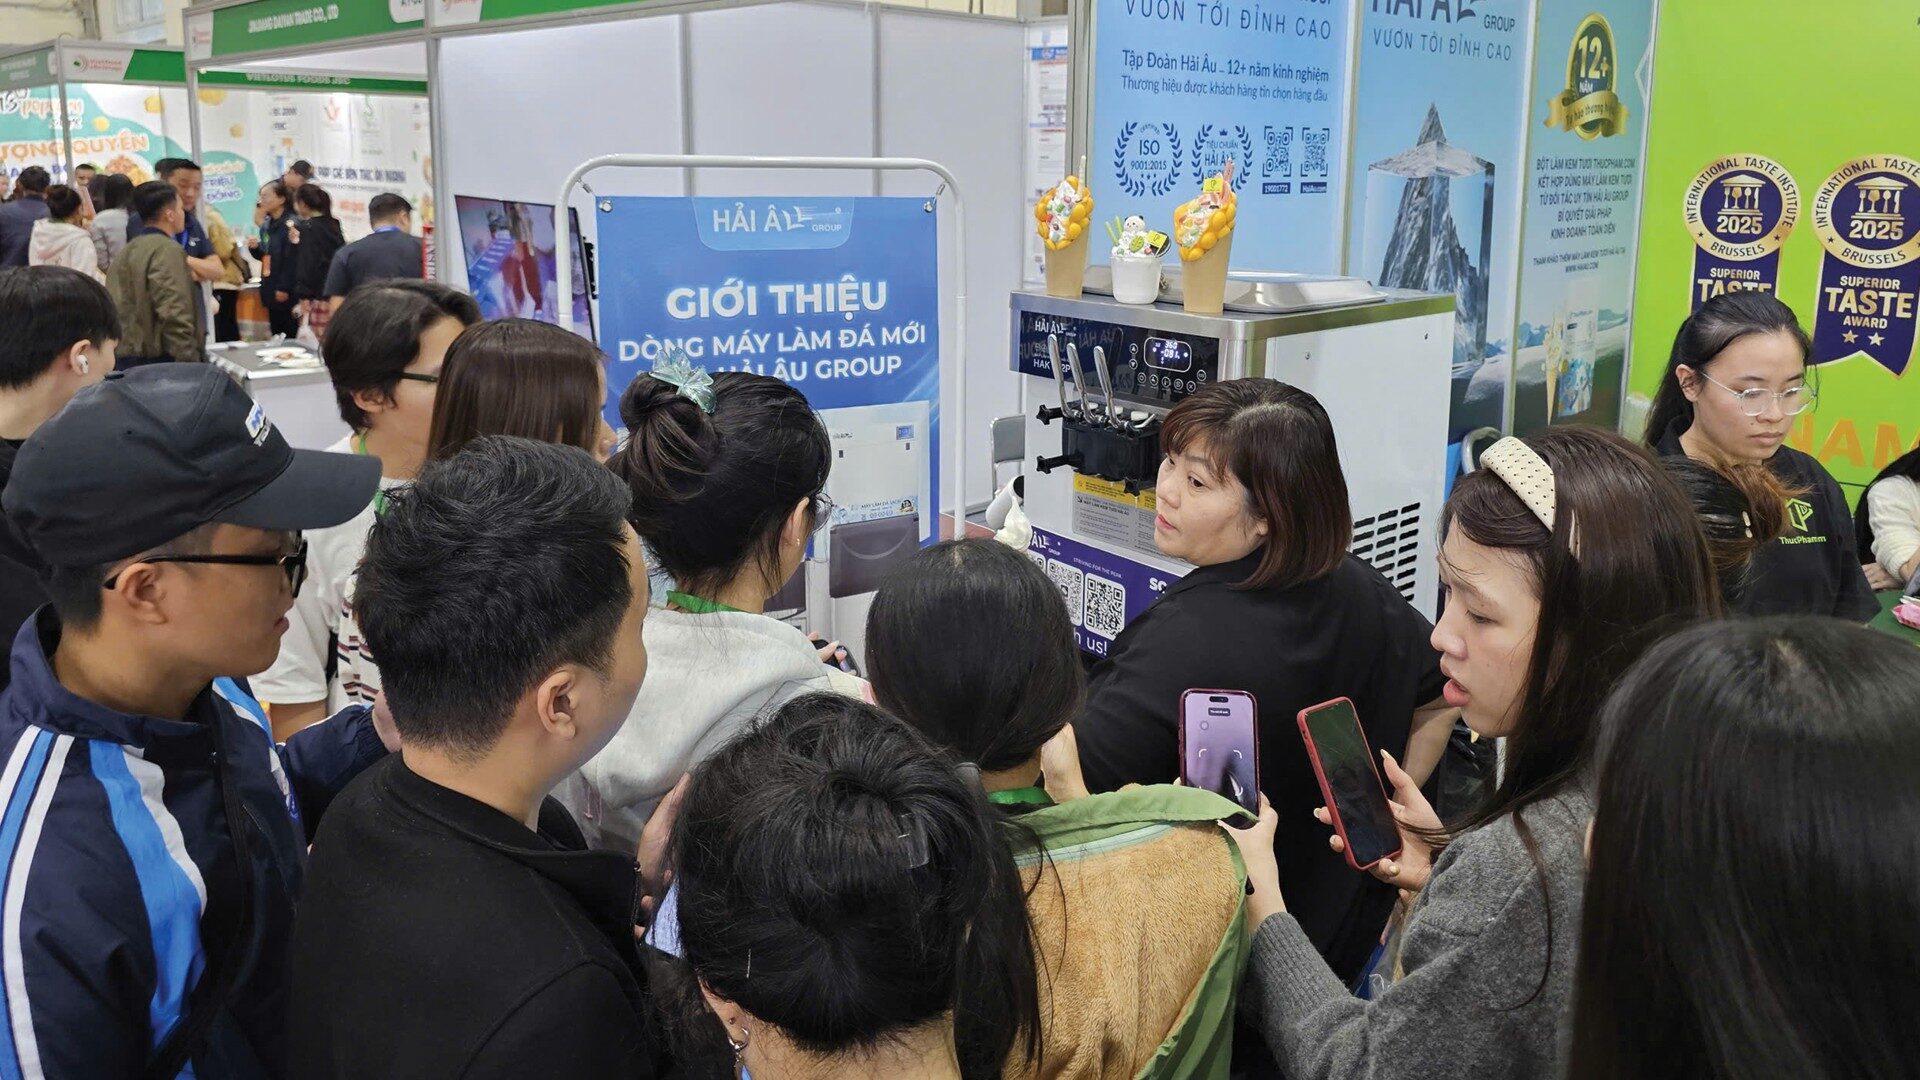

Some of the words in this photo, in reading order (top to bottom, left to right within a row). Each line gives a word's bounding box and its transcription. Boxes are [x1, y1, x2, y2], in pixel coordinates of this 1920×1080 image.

[1198, 1, 1229, 27] TỚI
[1240, 4, 1286, 34] ĐỈNH
[1296, 17, 1331, 40] CAO
[1484, 14, 1516, 32] GROUP
[1487, 43, 1512, 61] CAO
[1122, 50, 1143, 71] Tập
[1147, 52, 1177, 69] Đoàn
[1181, 54, 1199, 72] Hải
[1202, 53, 1217, 73] Âu
[1227, 60, 1246, 75] 12+
[1250, 64, 1270, 78] năm
[1273, 64, 1293, 79] kinh
[1295, 66, 1329, 83] nghiệm
[1121, 75, 1159, 94] Thương
[1162, 78, 1182, 93] hiệu
[1184, 80, 1207, 95] được
[1210, 82, 1234, 97] khách
[1237, 83, 1257, 100] hàng
[1259, 86, 1270, 98] tin
[1272, 86, 1291, 100] chọn
[1293, 87, 1312, 102] hàng
[1139, 140, 1160, 155] ISO
[1130, 161, 1167, 170] 9001:2015
[1687, 157, 1739, 224] INTERNATIONAL
[1744, 157, 1778, 175] TASTE
[1776, 172, 1798, 229] INSTITUTE
[1815, 158, 1877, 228] INTERNATIONAL
[713, 201, 756, 232] HẢI
[1716, 215, 1762, 234] 2025
[812, 224, 842, 232] GROUP
[1849, 220, 1904, 240] 2025
[1710, 241, 1766, 257] BRUSSELS
[1841, 247, 1907, 264] BRUSSELS
[1710, 267, 1761, 280] SUPERIOR
[1839, 275, 1901, 290] SUPERIOR
[666, 278, 758, 320] GIỚI
[769, 275, 887, 321] THIỆU
[1825, 287, 1915, 319] TASTE
[1034, 318, 1049, 333] HẢI
[1842, 316, 1888, 330] AWARD
[619, 333, 704, 362] DÒNG
[713, 326, 770, 356] MÁY
[778, 324, 832, 352] LÀM
[839, 323, 875, 348] ĐÁ
[882, 320, 926, 346] MỚI
[773, 357, 808, 381] ÂU
[814, 355, 902, 381] GROUP
[1092, 564, 1100, 572] FOR
[1100, 566, 1110, 575] THE
[1086, 636, 1108, 656] us!
